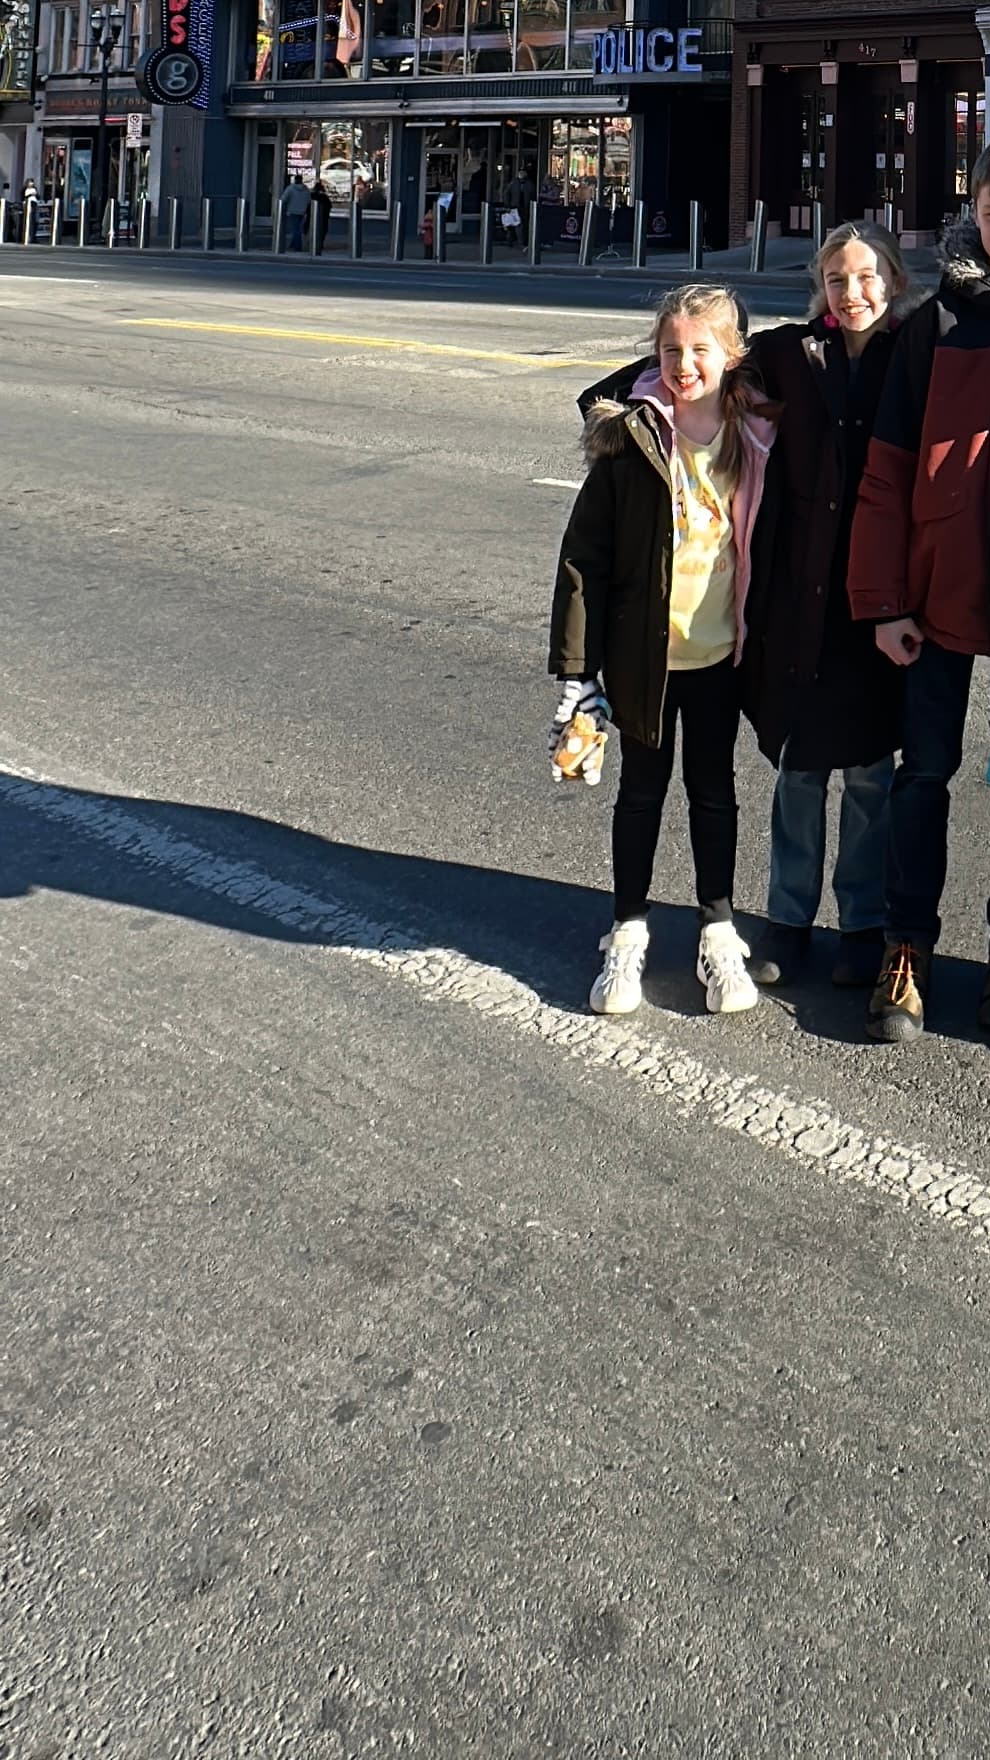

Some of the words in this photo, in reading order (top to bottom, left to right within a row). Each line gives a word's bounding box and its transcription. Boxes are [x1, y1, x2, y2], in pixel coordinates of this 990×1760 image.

[593, 28, 703, 74] POLICE
[858, 42, 877, 57] 417
[166, 61, 188, 90] g
[561, 81, 576, 92] 411
